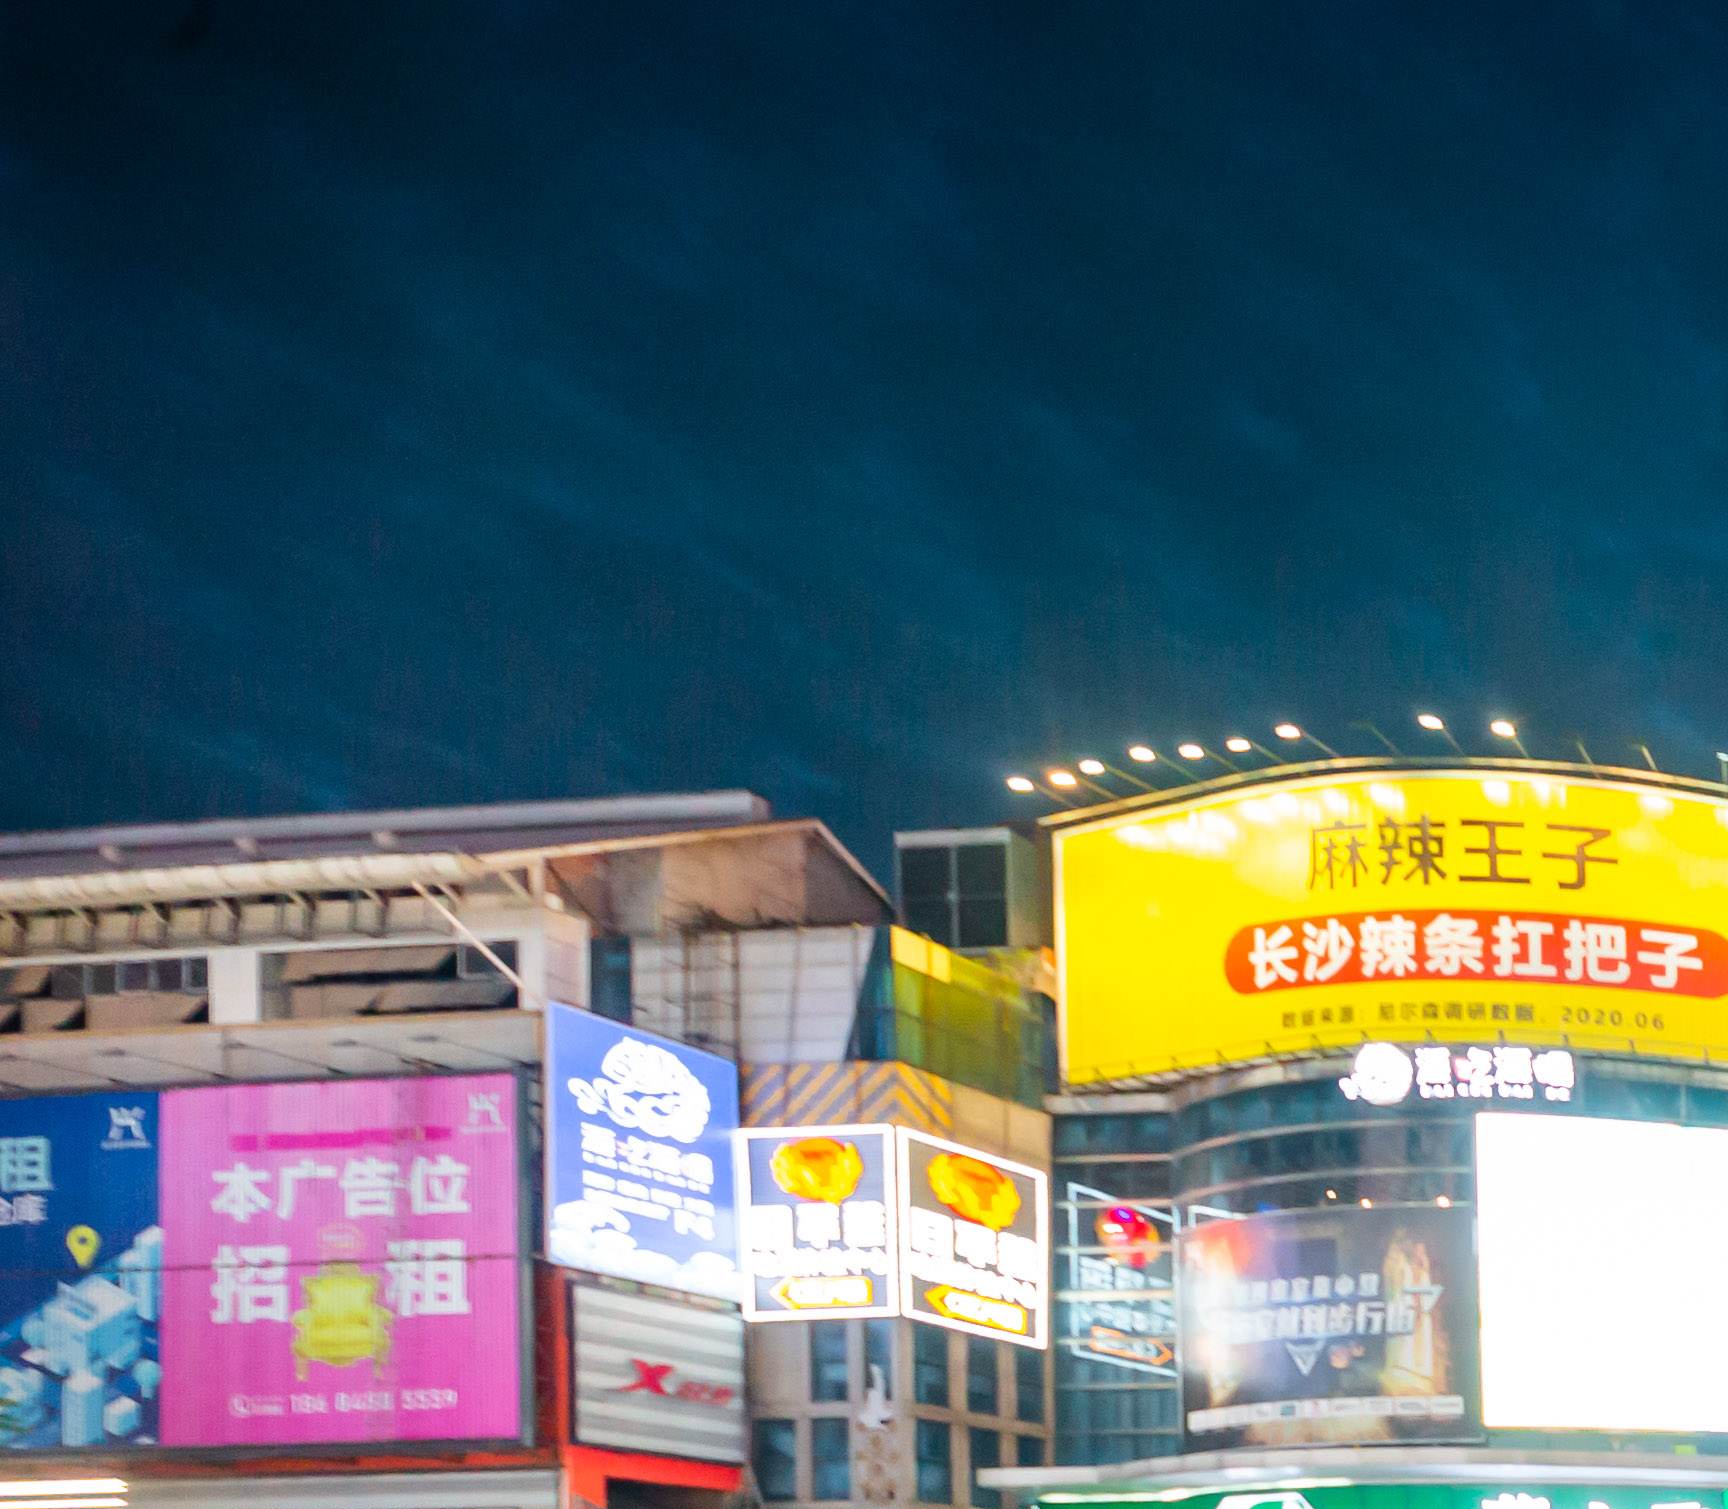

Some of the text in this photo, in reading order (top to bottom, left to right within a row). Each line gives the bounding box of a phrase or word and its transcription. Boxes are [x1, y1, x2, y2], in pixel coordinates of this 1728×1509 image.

[1307, 815, 1620, 891] 麻辣王子
[1248, 916, 1702, 990] 长沙辣条扛把子
[211, 1155, 470, 1224] 本广告位
[210, 1240, 470, 1324] 招 租
